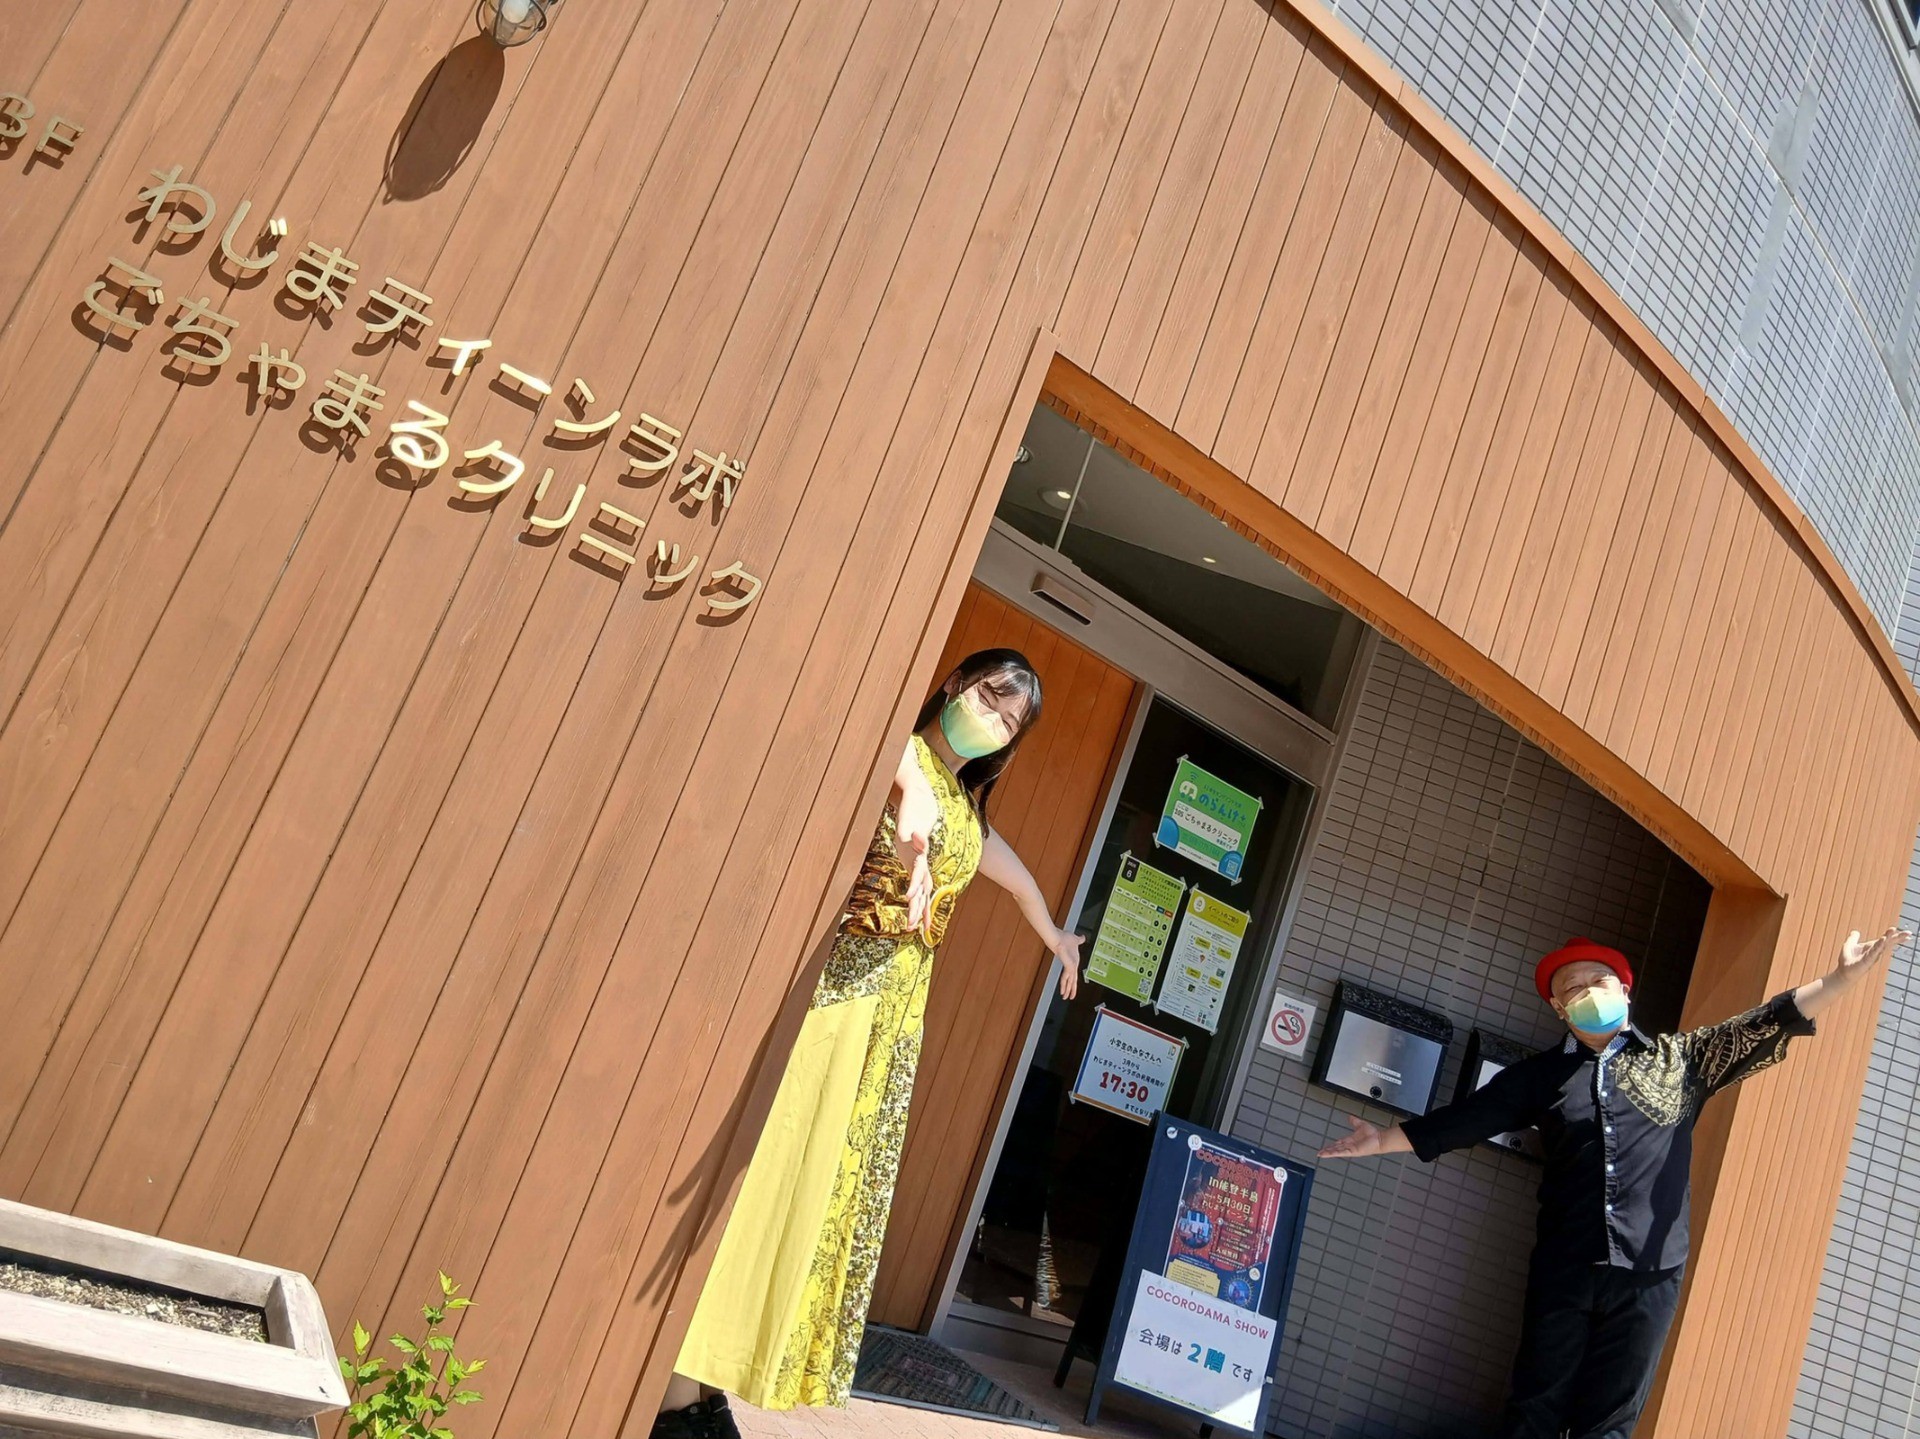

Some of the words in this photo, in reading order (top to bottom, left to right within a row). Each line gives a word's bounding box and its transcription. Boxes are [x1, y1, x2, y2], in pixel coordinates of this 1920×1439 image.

[136, 164, 746, 508] わじまティーンラボ
[83, 256, 763, 611] ごちゃまるクリニック
[1109, 1037, 1162, 1064] 小学生のみなさんへ
[1121, 1058, 1141, 1071] 3月から
[1099, 1071, 1149, 1103] 17:30
[1124, 1103, 1154, 1119] までとなりま
[1208, 1176, 1259, 1204] in能登半島
[1146, 1285, 1231, 1326] COCORODAMA
[1234, 1319, 1269, 1340] SHOW
[1139, 1328, 1183, 1355] 会場は
[1187, 1343, 1226, 1374] 2階
[1232, 1363, 1253, 1382] です
